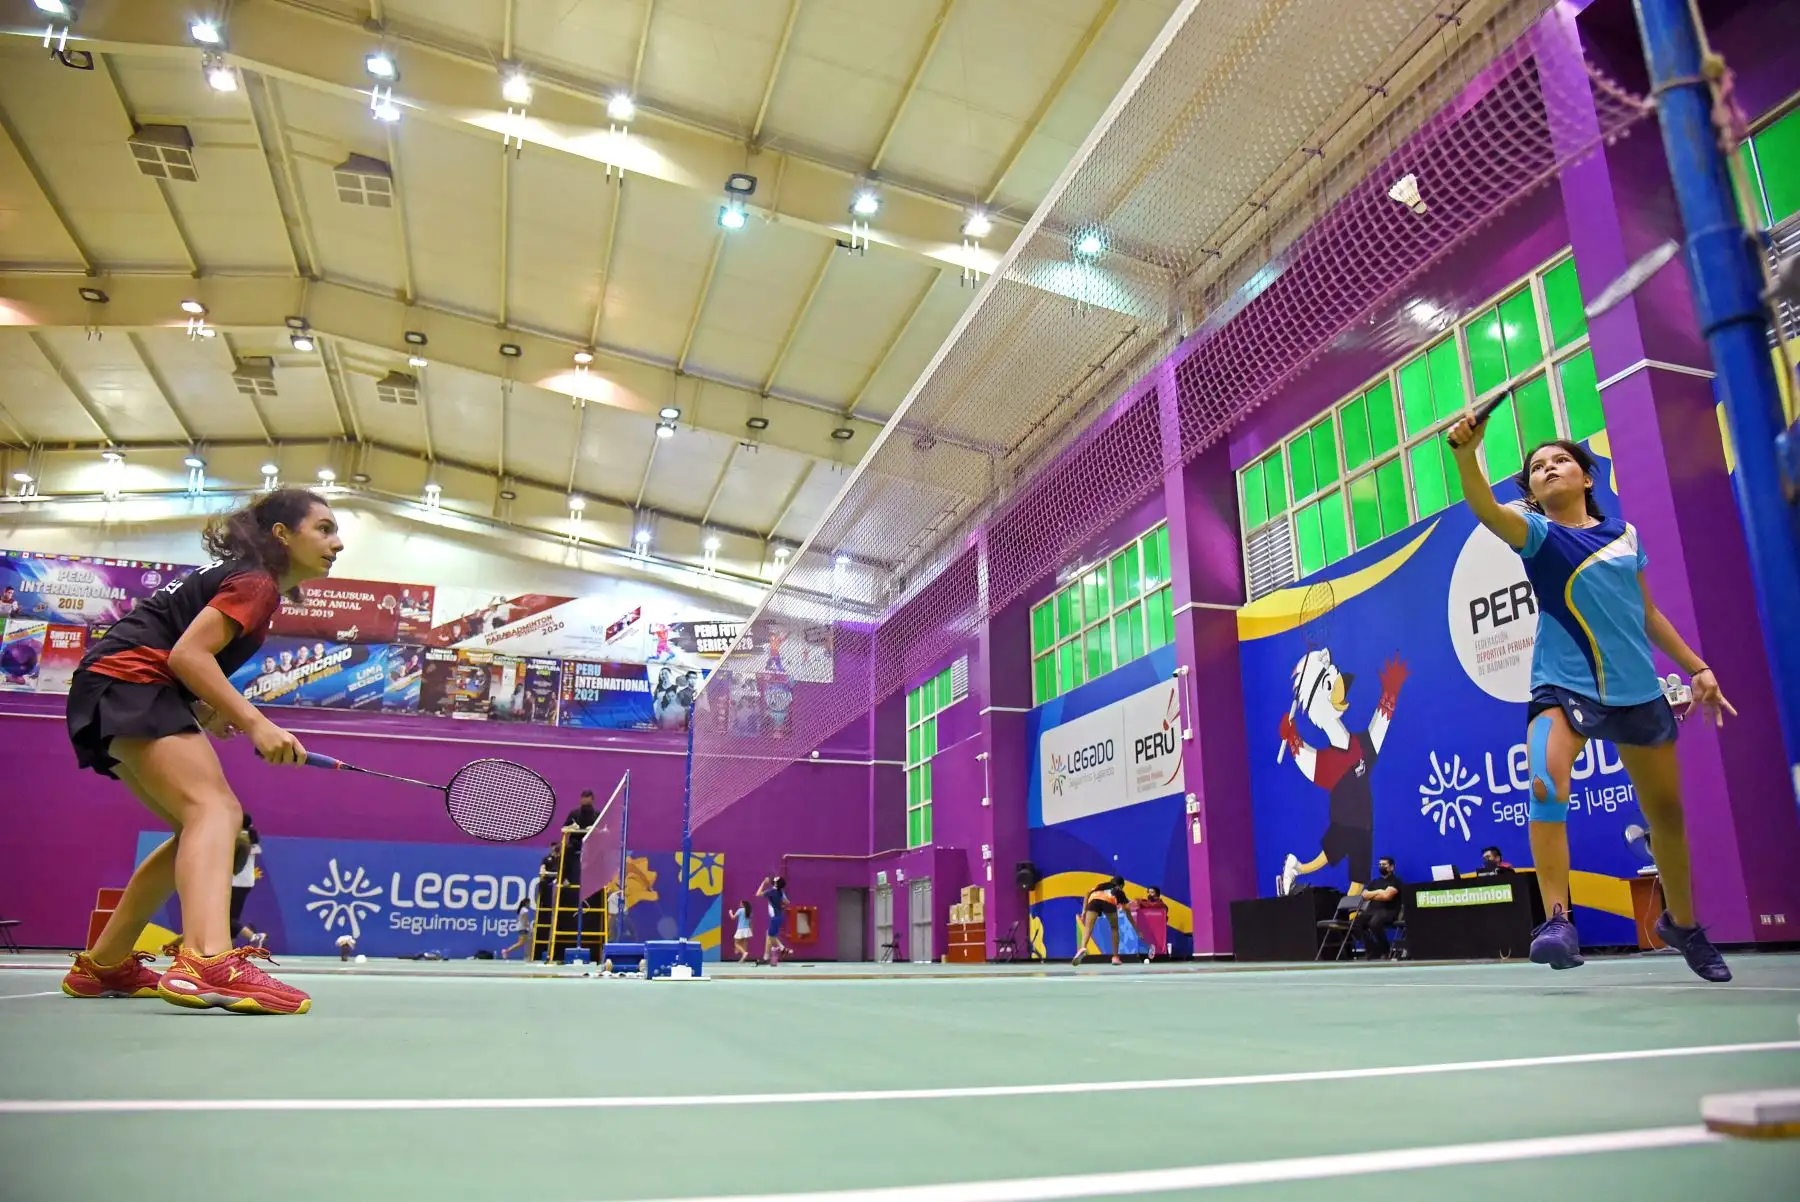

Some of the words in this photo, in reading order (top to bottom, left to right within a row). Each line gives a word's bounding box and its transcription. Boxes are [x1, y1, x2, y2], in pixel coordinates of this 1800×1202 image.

[20, 581, 127, 600] INTERNATIONAL
[306, 588, 322, 597] DE
[323, 590, 375, 601] CLAUSURA
[58, 598, 84, 610] 2019
[328, 600, 362, 610] ANUAL
[1470, 580, 1536, 635] PER
[310, 609, 335, 618] 2019
[542, 621, 565, 636] 2020
[244, 647, 353, 700] SUDAMERICANO
[575, 663, 602, 677] PERU
[574, 675, 650, 693] INTERNATIONAL
[574, 688, 600, 702] 2021
[389, 911, 478, 935] Seguimos
[482, 915, 521, 937] juga
